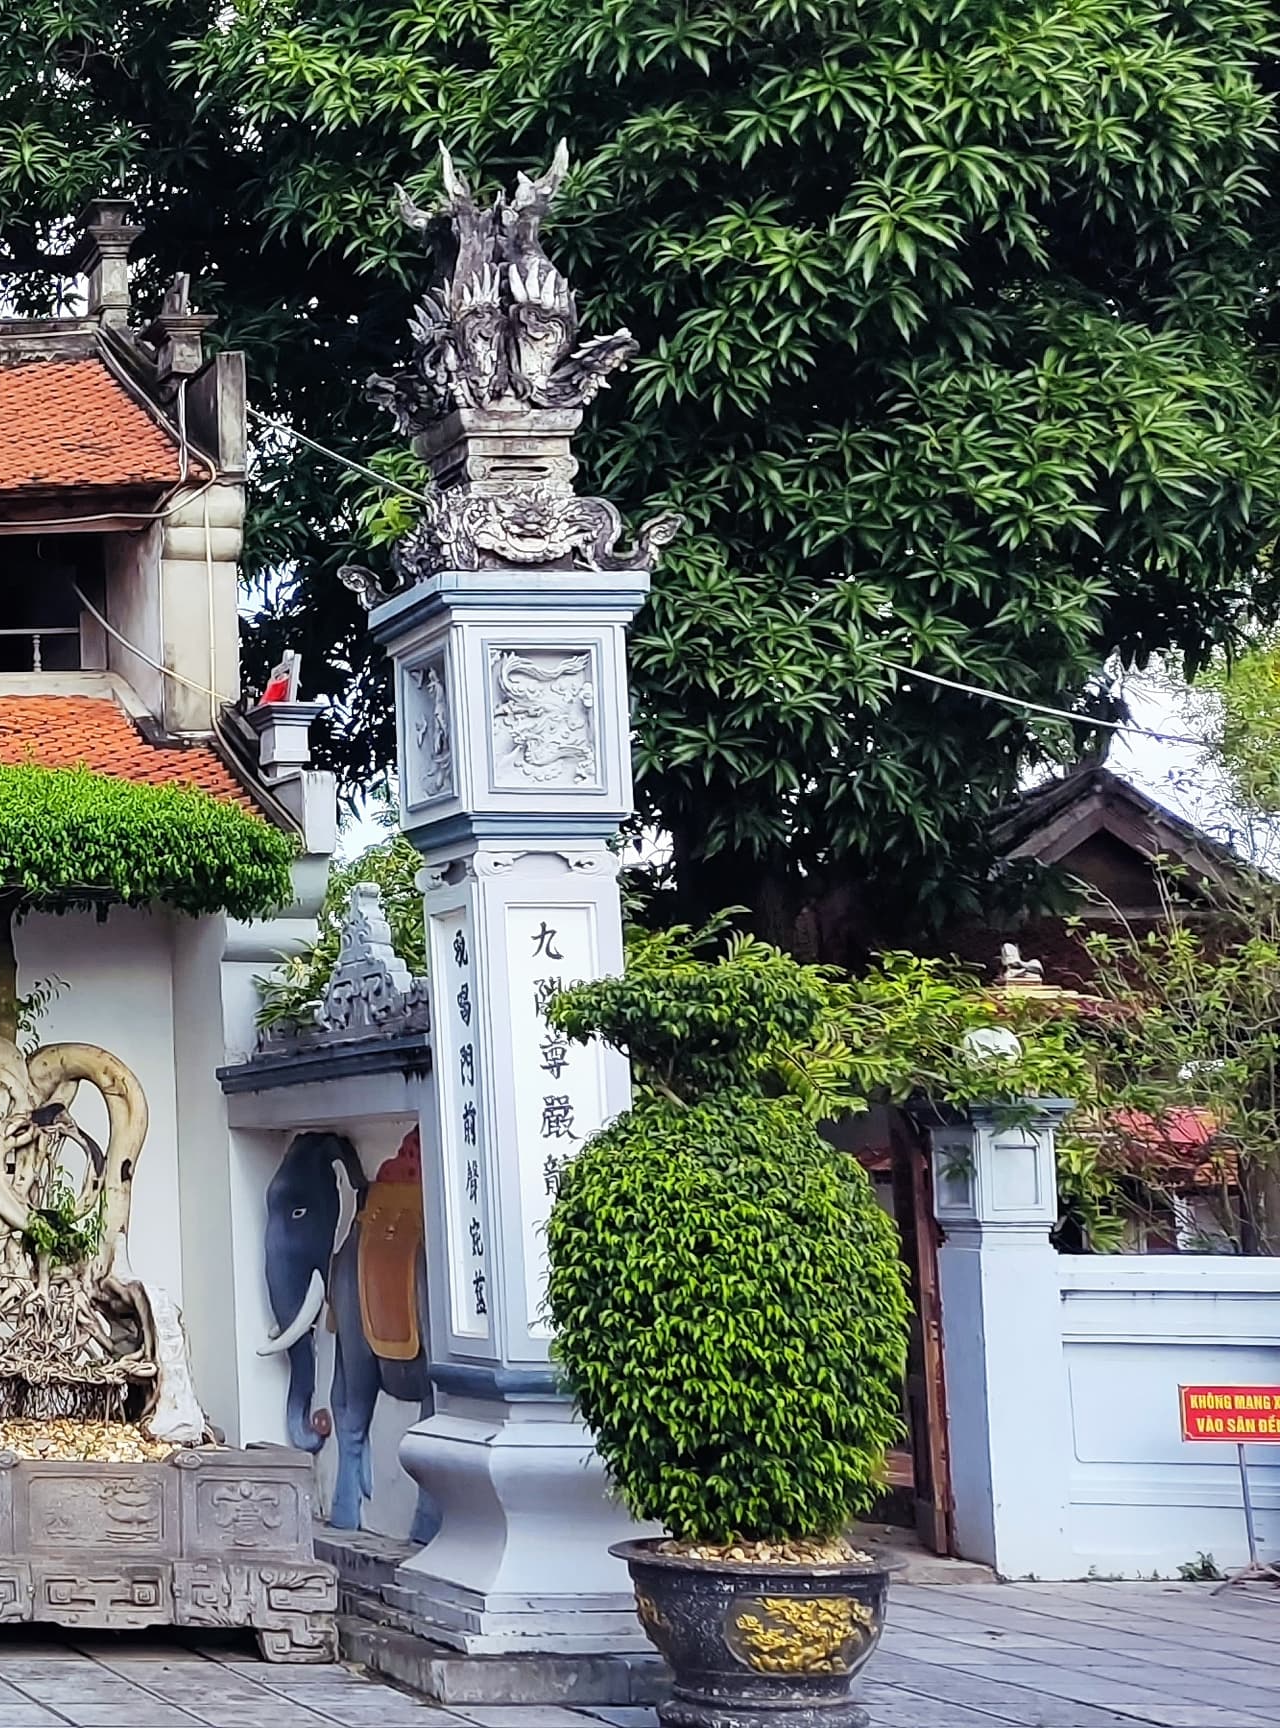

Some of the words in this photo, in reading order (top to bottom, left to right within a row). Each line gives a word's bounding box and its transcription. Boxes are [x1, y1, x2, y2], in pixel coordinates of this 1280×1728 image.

[1190, 1391, 1232, 1409] KHÔNG
[1234, 1395, 1271, 1410] MANG
[1196, 1415, 1224, 1432] VÀO
[1227, 1415, 1256, 1432] SÂN
